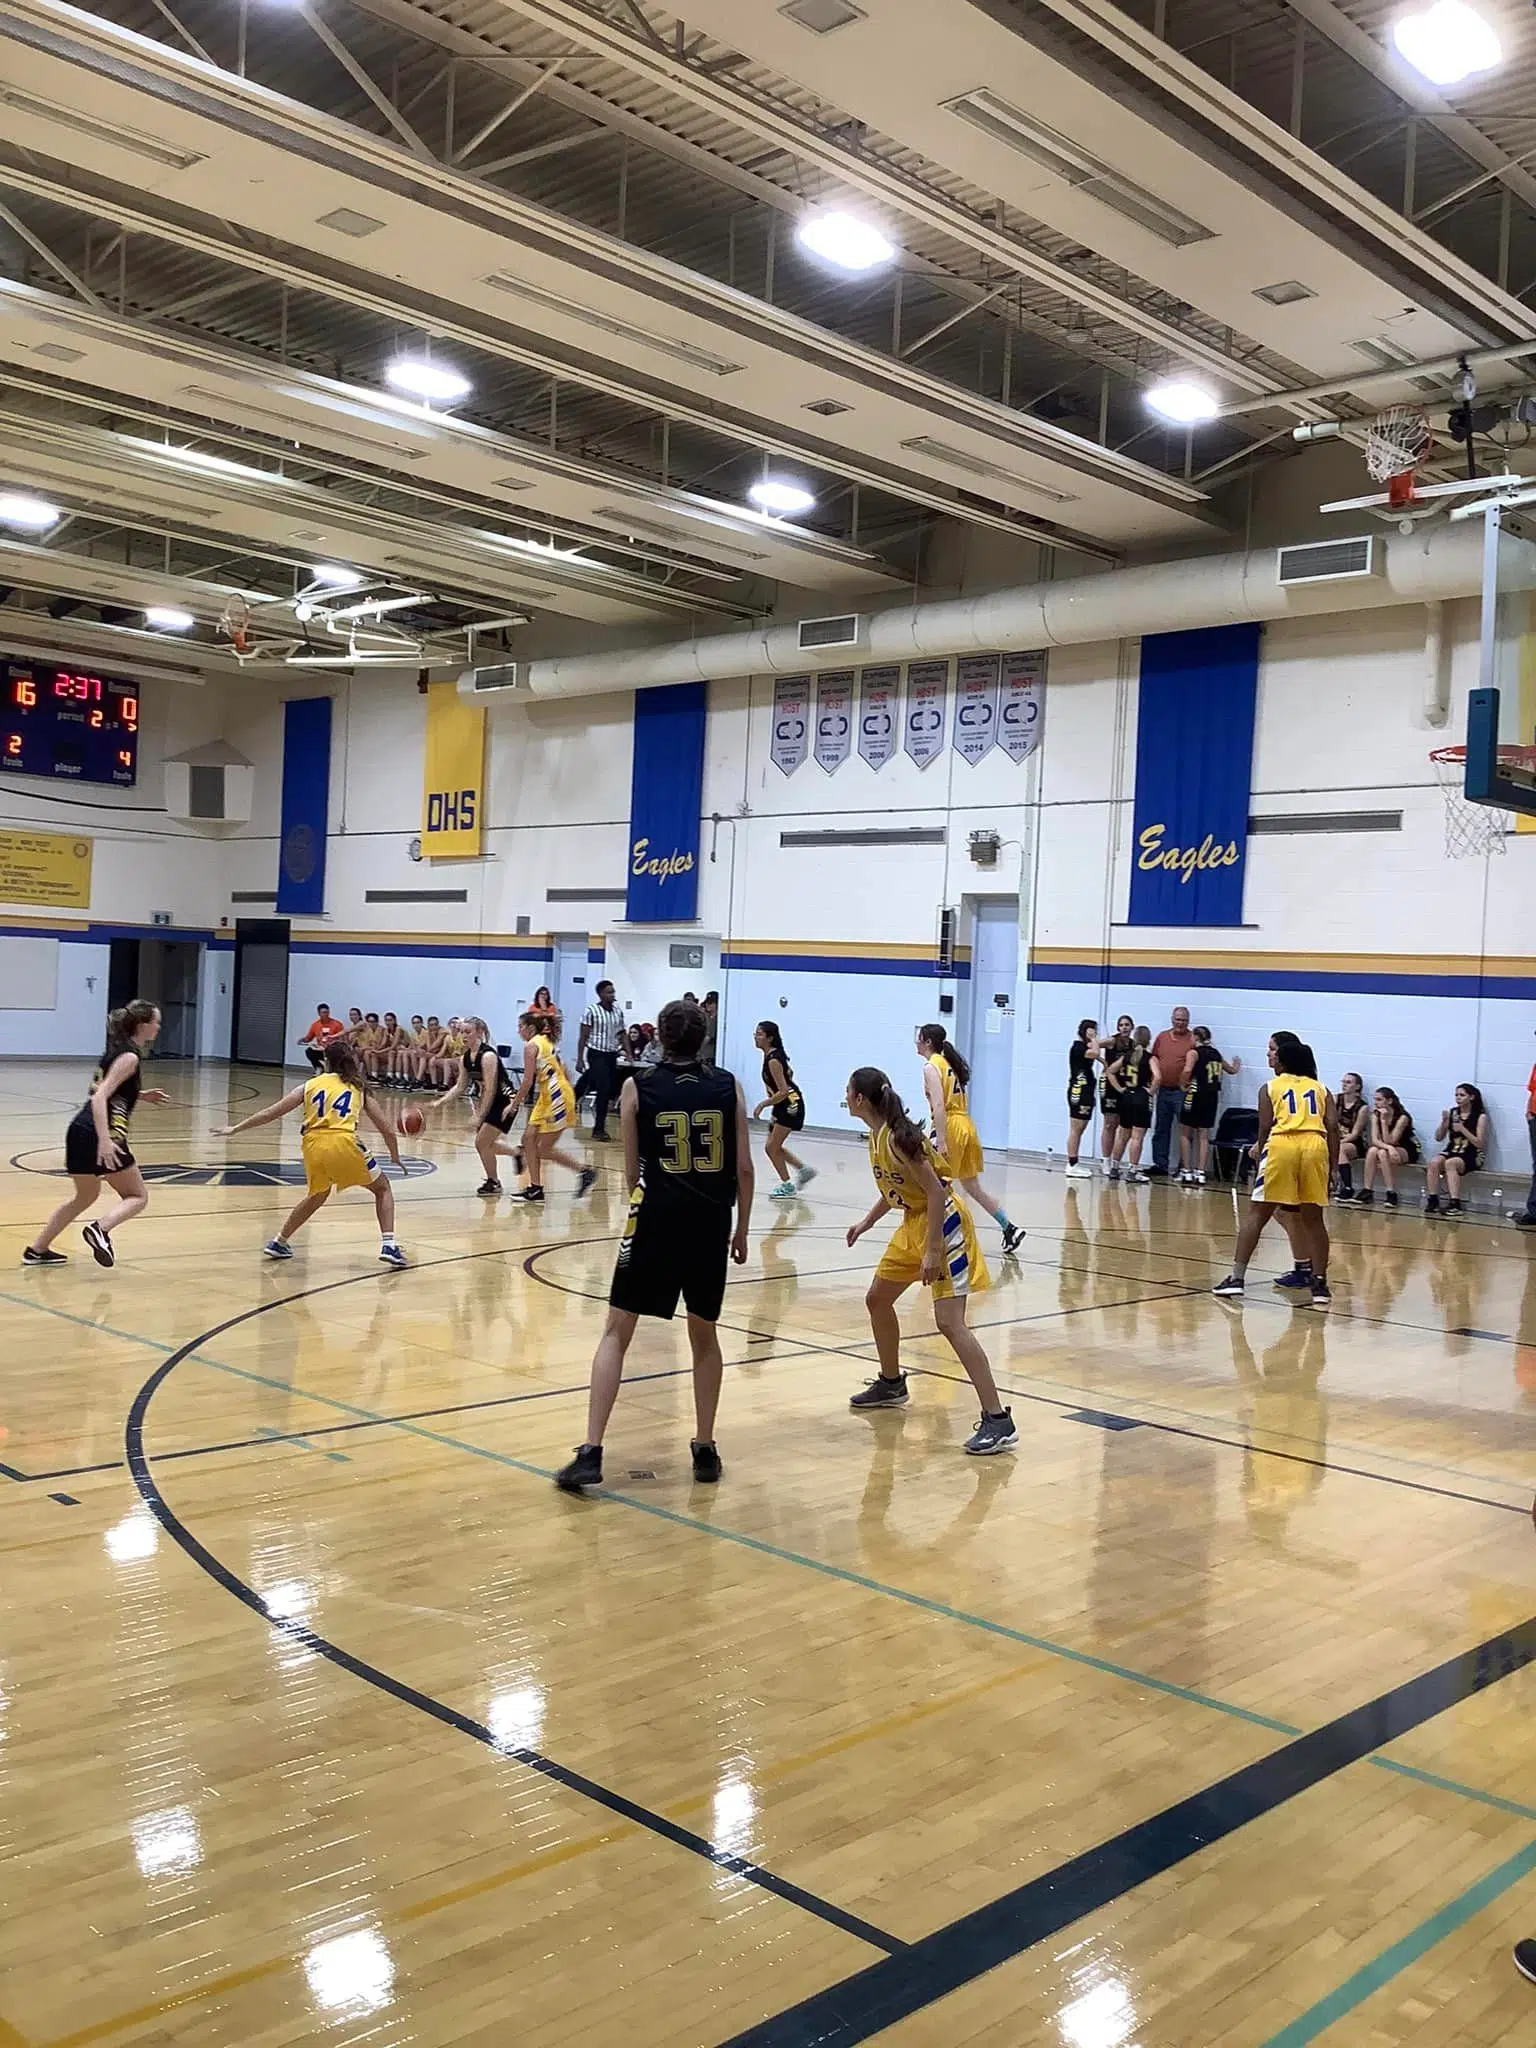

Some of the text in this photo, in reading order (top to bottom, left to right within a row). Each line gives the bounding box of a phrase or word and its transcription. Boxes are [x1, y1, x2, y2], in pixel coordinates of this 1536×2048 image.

[17, 681, 36, 706] 16
[55, 673, 101, 700] 2:37
[91, 710, 103, 727] 2
[123, 697, 137, 720] 0
[9, 735, 22, 753] 2
[964, 744, 984, 753] 2014
[1008, 741, 1028, 750] 2015
[119, 751, 131, 766] 4
[427, 790, 475, 832] DHS
[632, 838, 694, 886] Eagles
[1138, 823, 1240, 884] Eagles
[311, 1089, 354, 1118] 14
[1282, 1087, 1318, 1115] 11
[656, 1110, 724, 1174] 33
